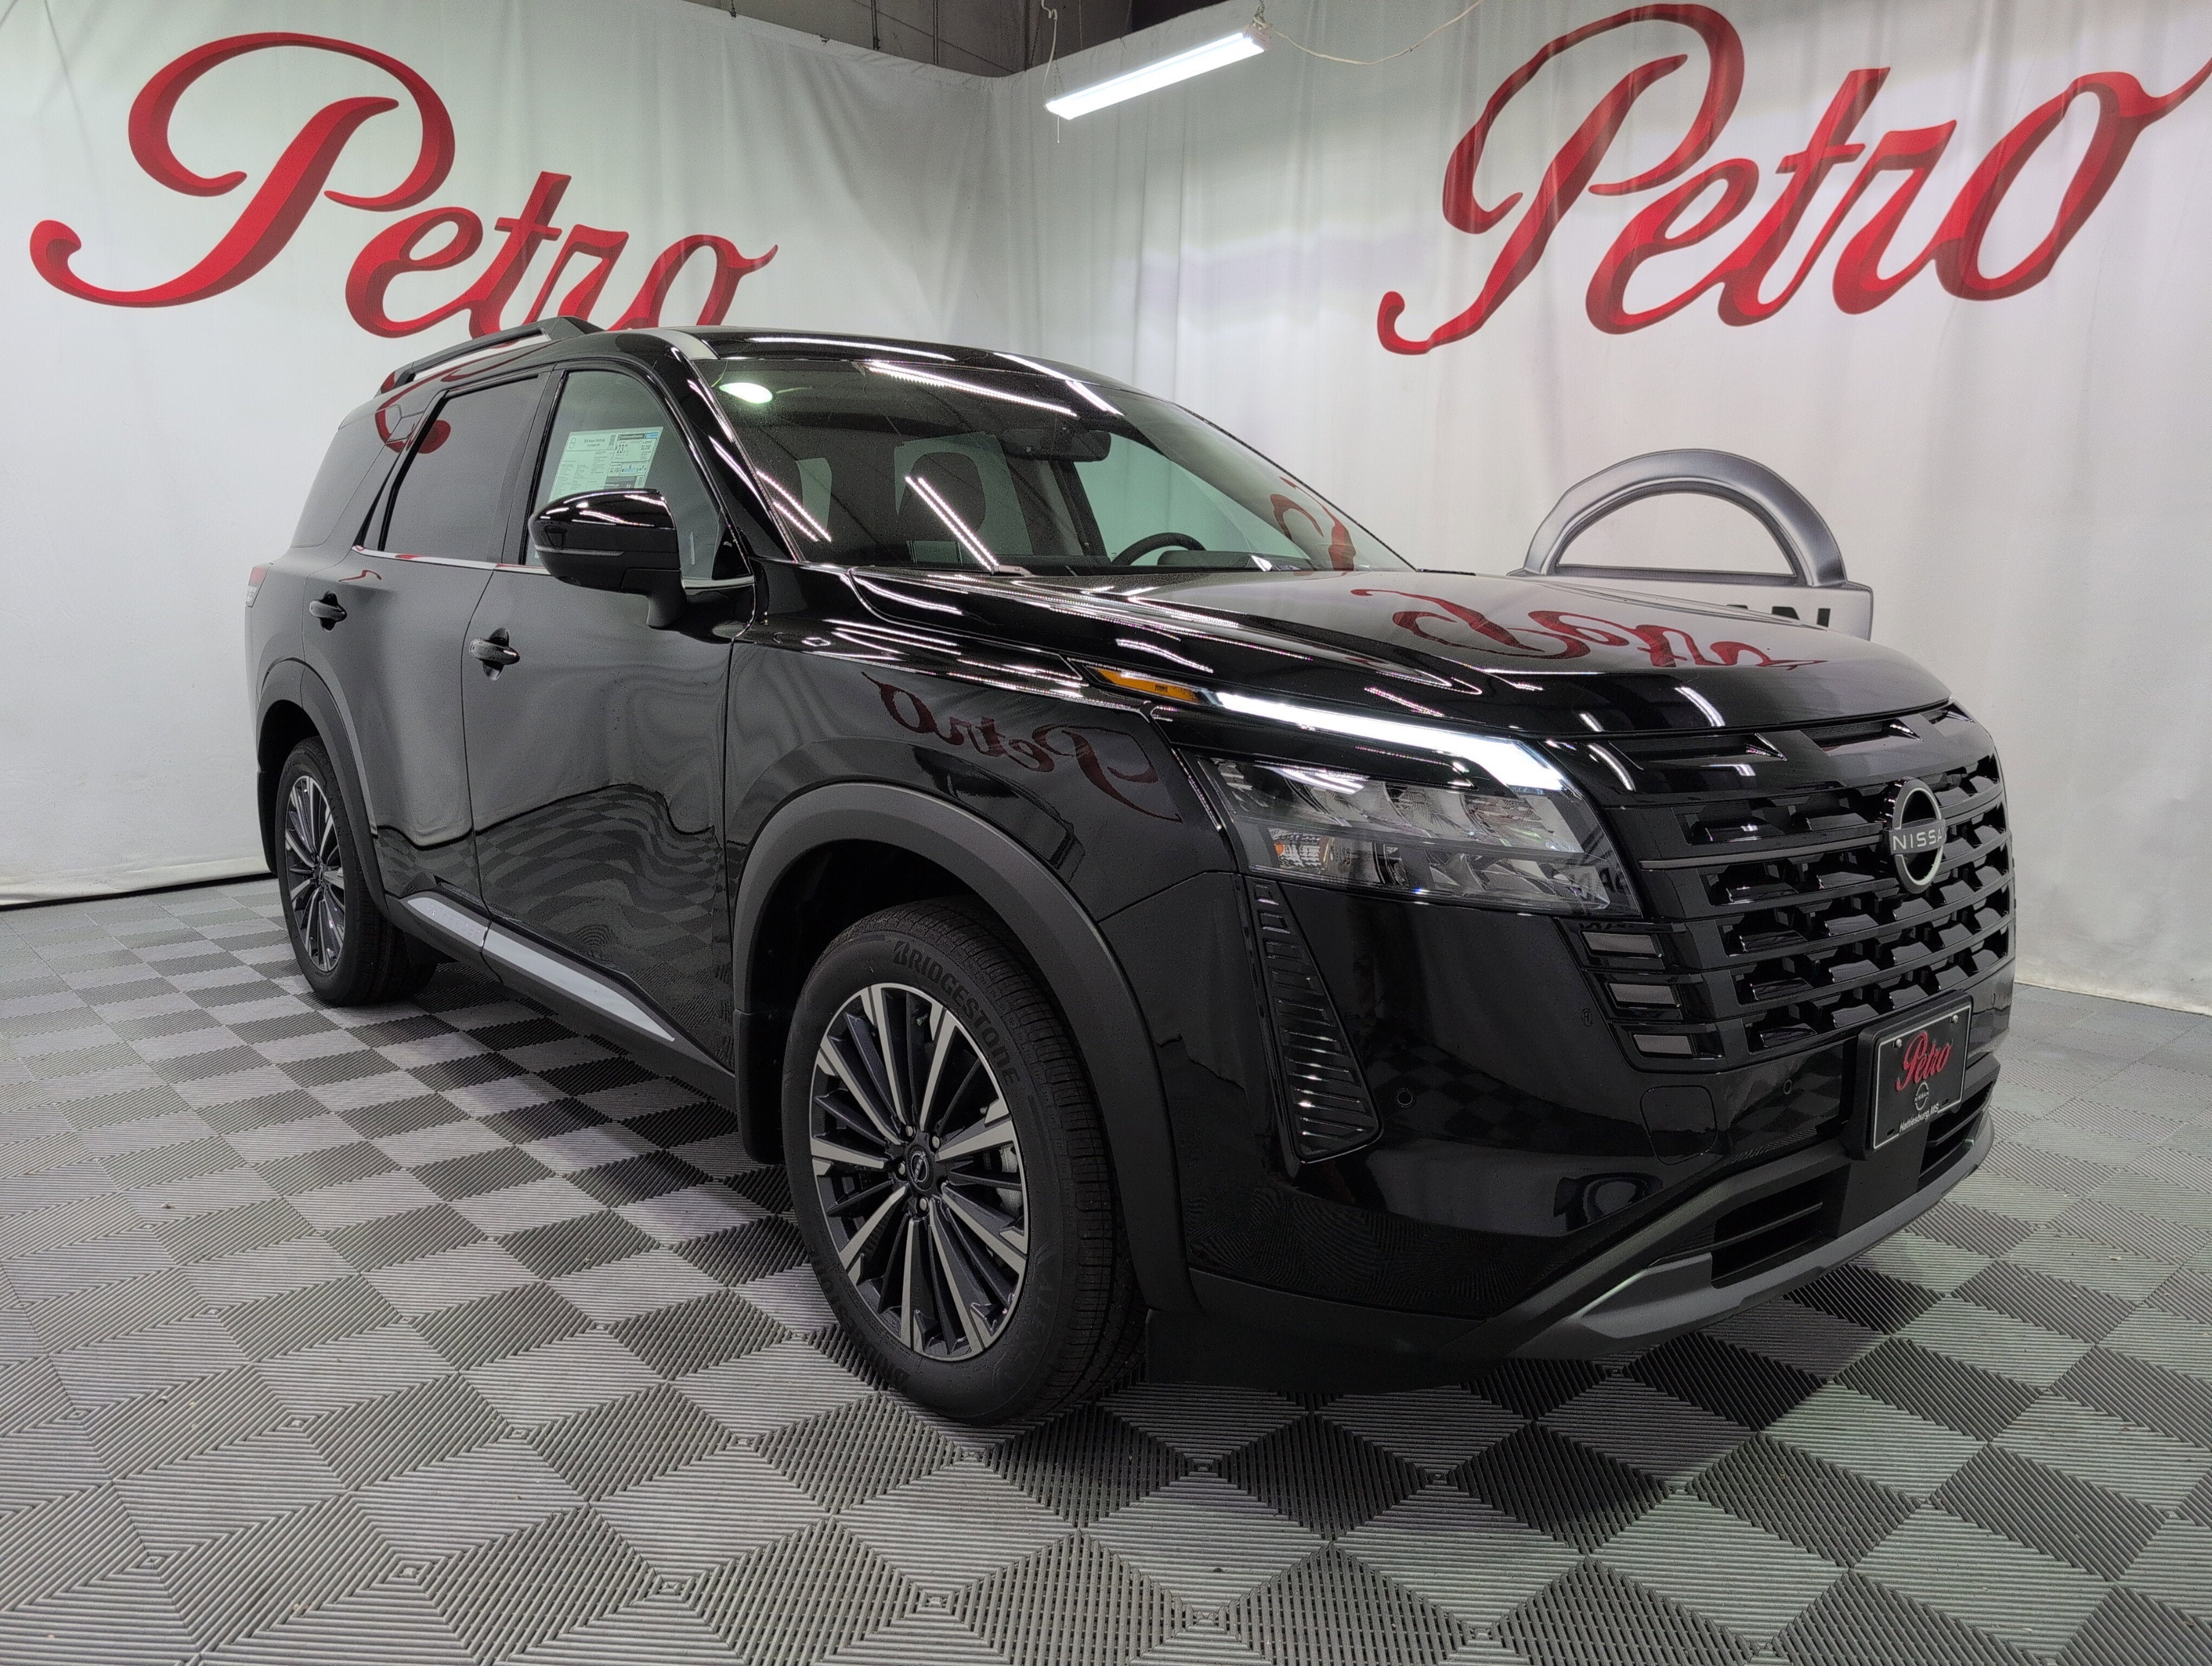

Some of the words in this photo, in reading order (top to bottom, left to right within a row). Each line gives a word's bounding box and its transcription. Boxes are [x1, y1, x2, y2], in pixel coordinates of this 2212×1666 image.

[30, 31, 779, 342] Petro
[1377, 3, 2212, 356] Petro
[616, 444, 625, 453] 23
[892, 940, 1023, 1086] BRIDGESTONE
[1896, 1031, 1953, 1091] Petro
[1931, 1103, 1939, 1115] MS
